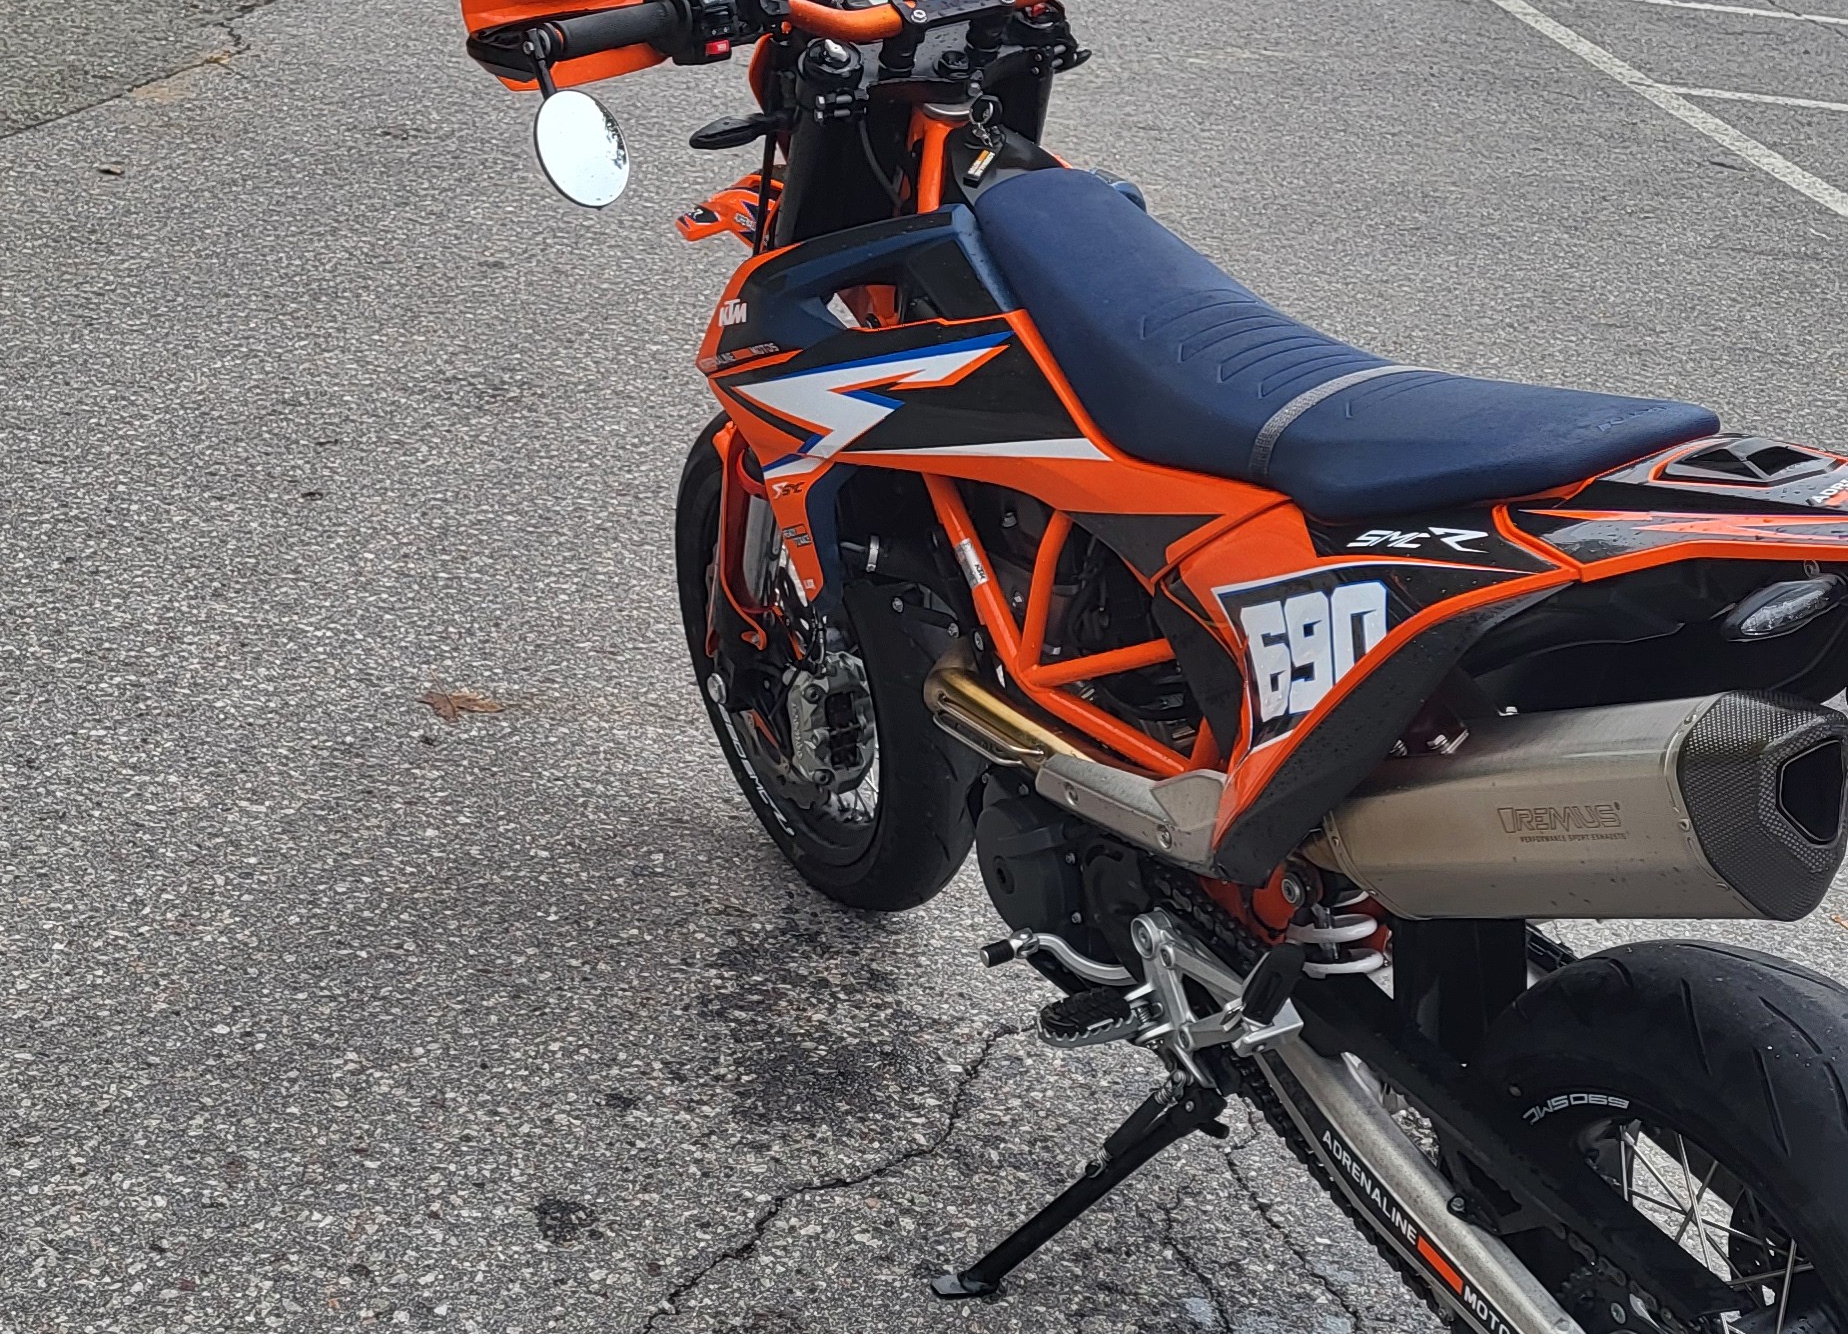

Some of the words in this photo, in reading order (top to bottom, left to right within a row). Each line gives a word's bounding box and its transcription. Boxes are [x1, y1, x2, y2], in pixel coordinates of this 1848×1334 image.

[718, 299, 748, 327] KTM
[1240, 581, 1388, 723] 690
[1514, 804, 1622, 832] REMUS
[1322, 1130, 1418, 1246] ADRENALINE
